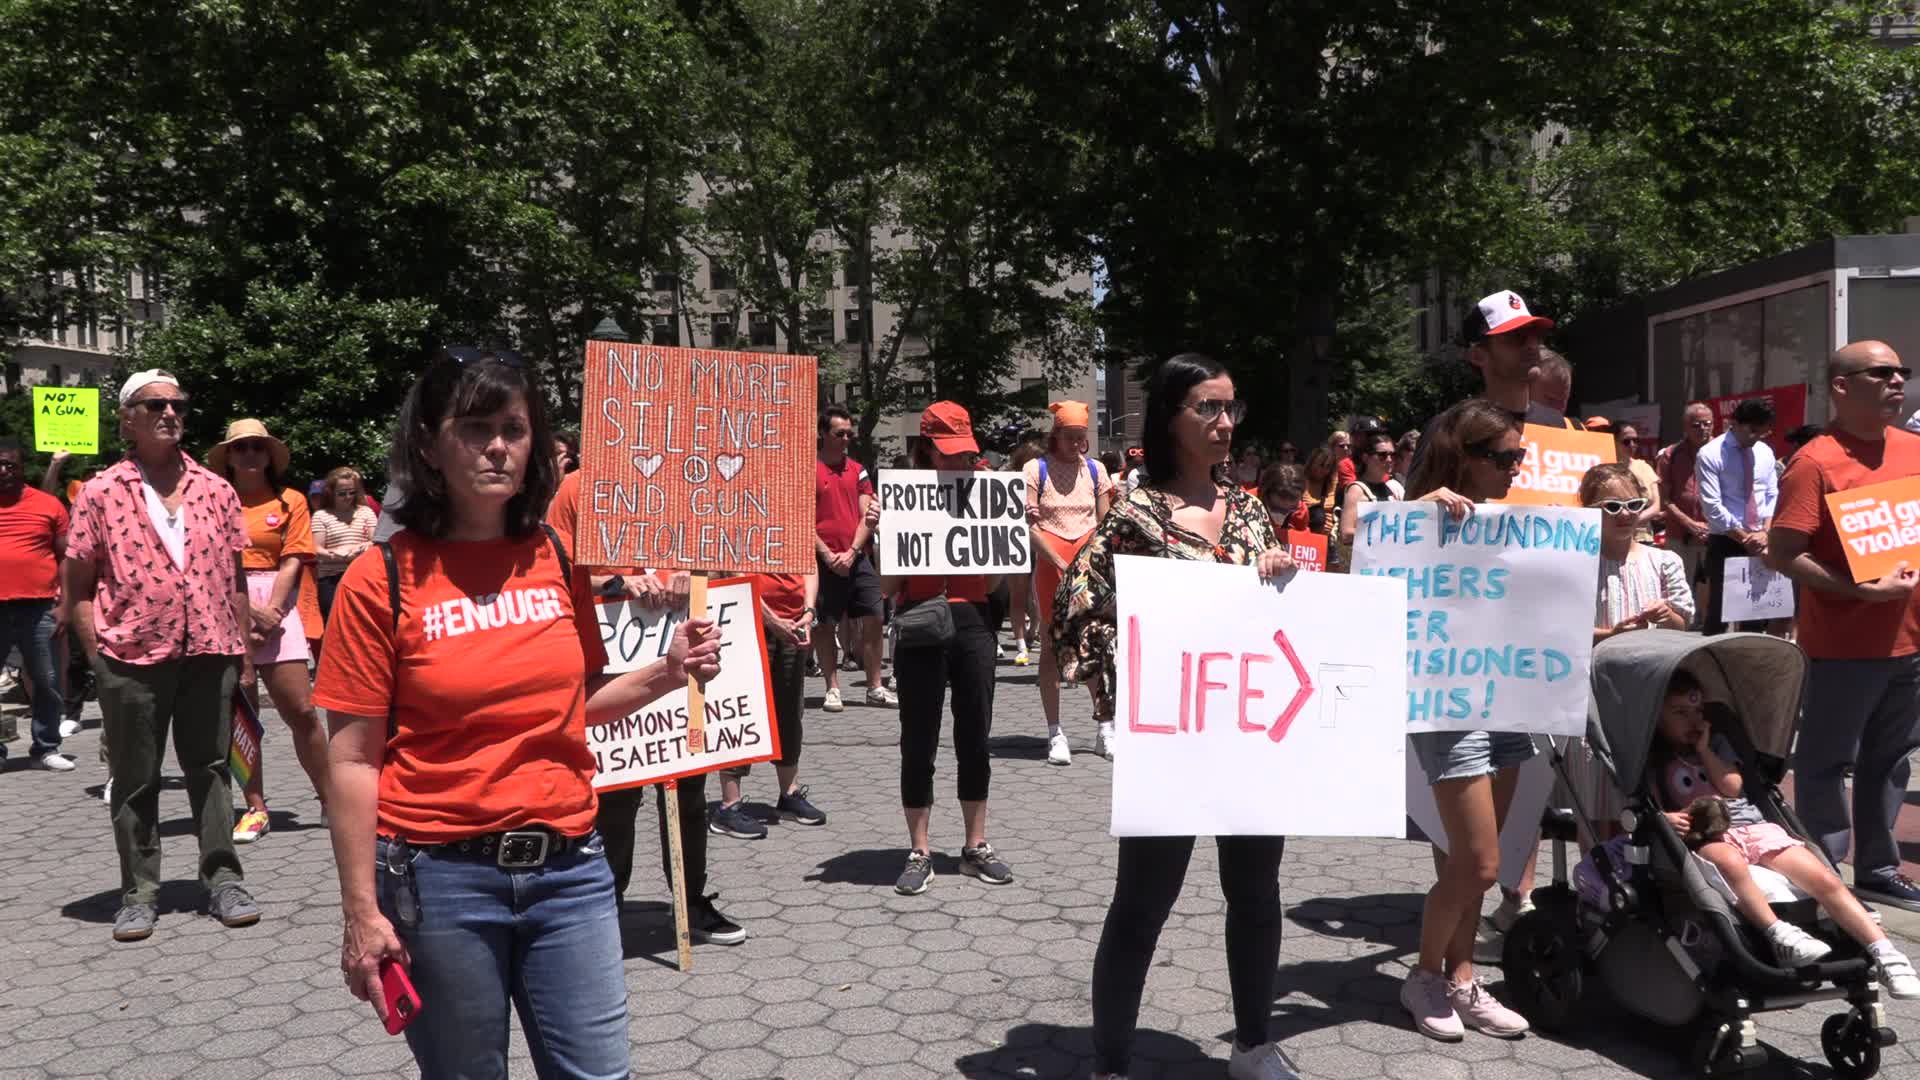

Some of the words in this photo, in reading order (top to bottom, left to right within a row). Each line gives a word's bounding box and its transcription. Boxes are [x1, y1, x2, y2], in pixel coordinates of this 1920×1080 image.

[607, 348, 663, 391] NO
[691, 358, 791, 404] MORE
[41, 405, 50, 415] A
[45, 393, 77, 403] NOT
[602, 397, 783, 453] SILENCE
[593, 480, 666, 515] END
[689, 487, 768, 518] GUN
[881, 483, 954, 512] PROTECT
[955, 478, 1025, 520] KIDS
[1840, 500, 1896, 533] end
[598, 519, 785, 565] VIOLENCE
[897, 532, 932, 568] NOT
[945, 525, 1028, 568] GUNS
[1363, 510, 1428, 547] THE
[1295, 544, 1317, 561] END
[422, 588, 564, 641] #ENOUGH
[233, 722, 256, 766] HATE
[704, 722, 761, 754] LAWS
